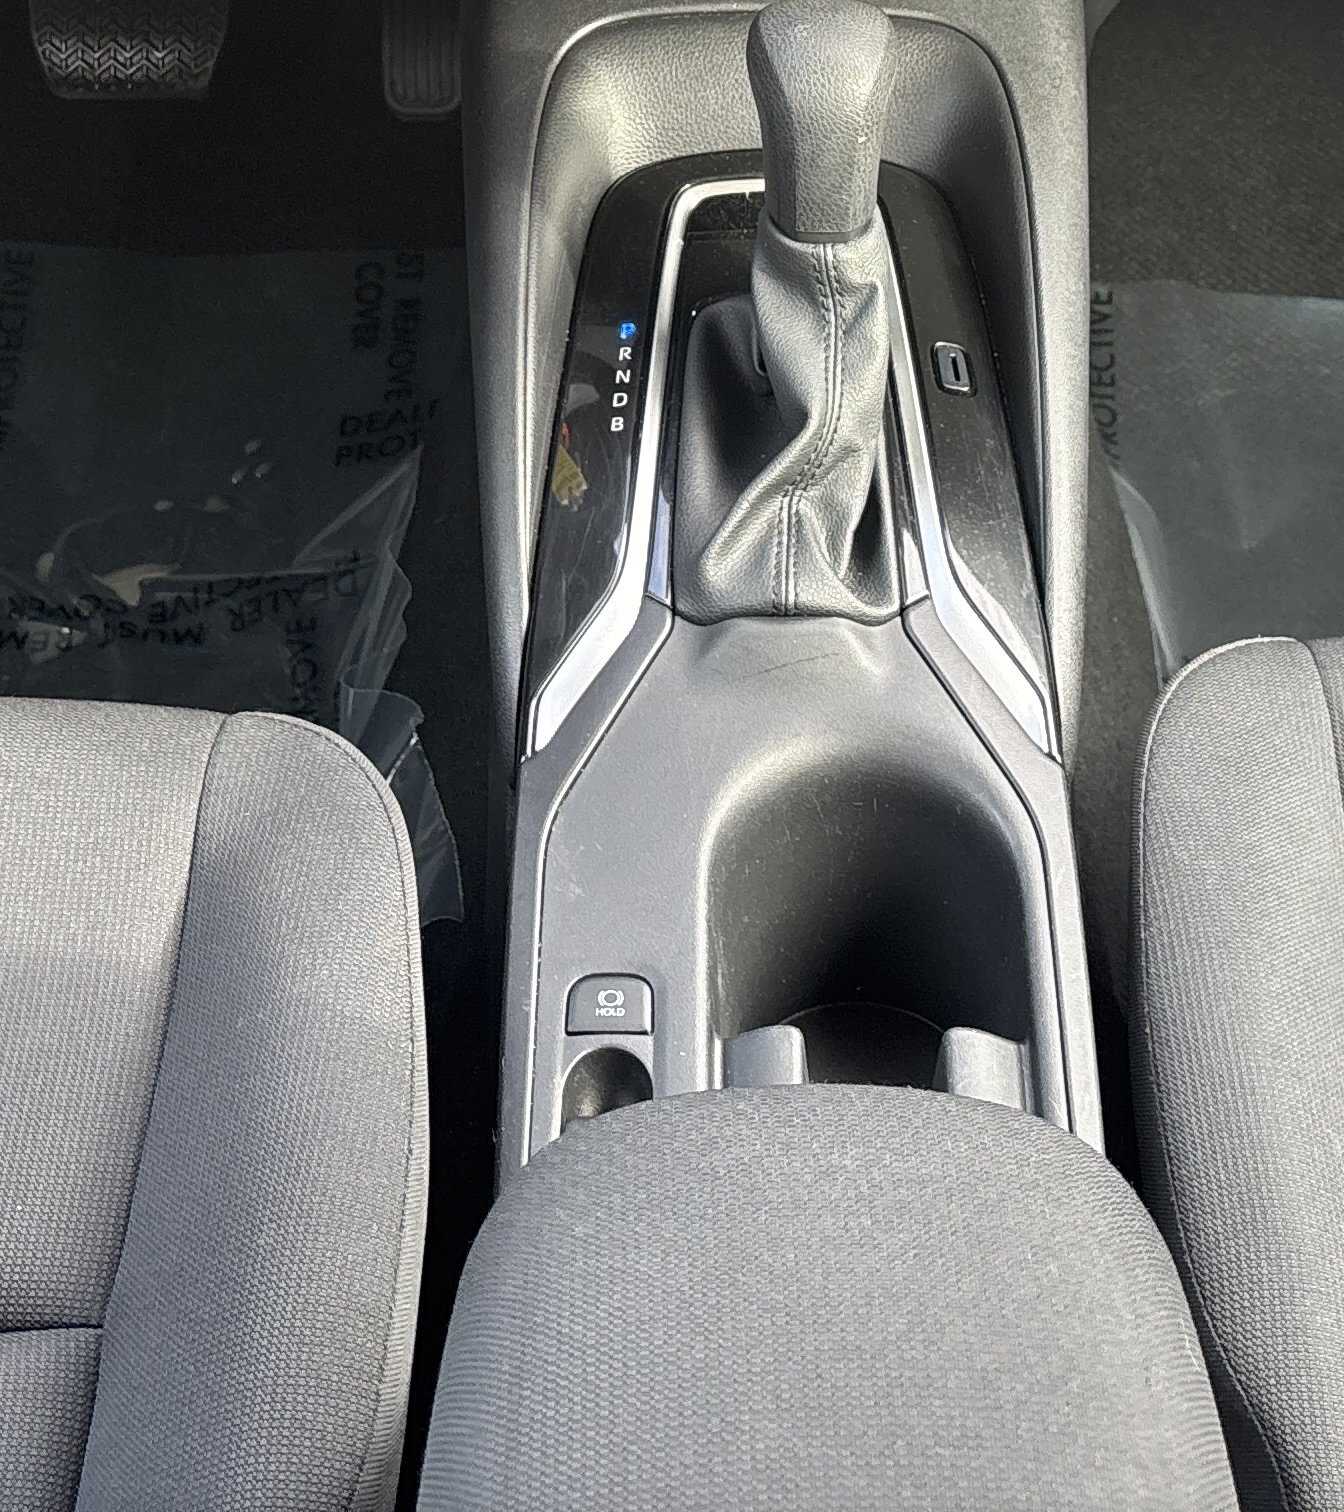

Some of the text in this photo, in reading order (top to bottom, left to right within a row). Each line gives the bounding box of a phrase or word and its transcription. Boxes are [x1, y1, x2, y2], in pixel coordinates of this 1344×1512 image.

[620, 322, 637, 339] P
[619, 346, 632, 361] R
[615, 369, 631, 384] N
[612, 392, 628, 407] D
[610, 416, 624, 431] B
[595, 1006, 625, 1017] HOLD
